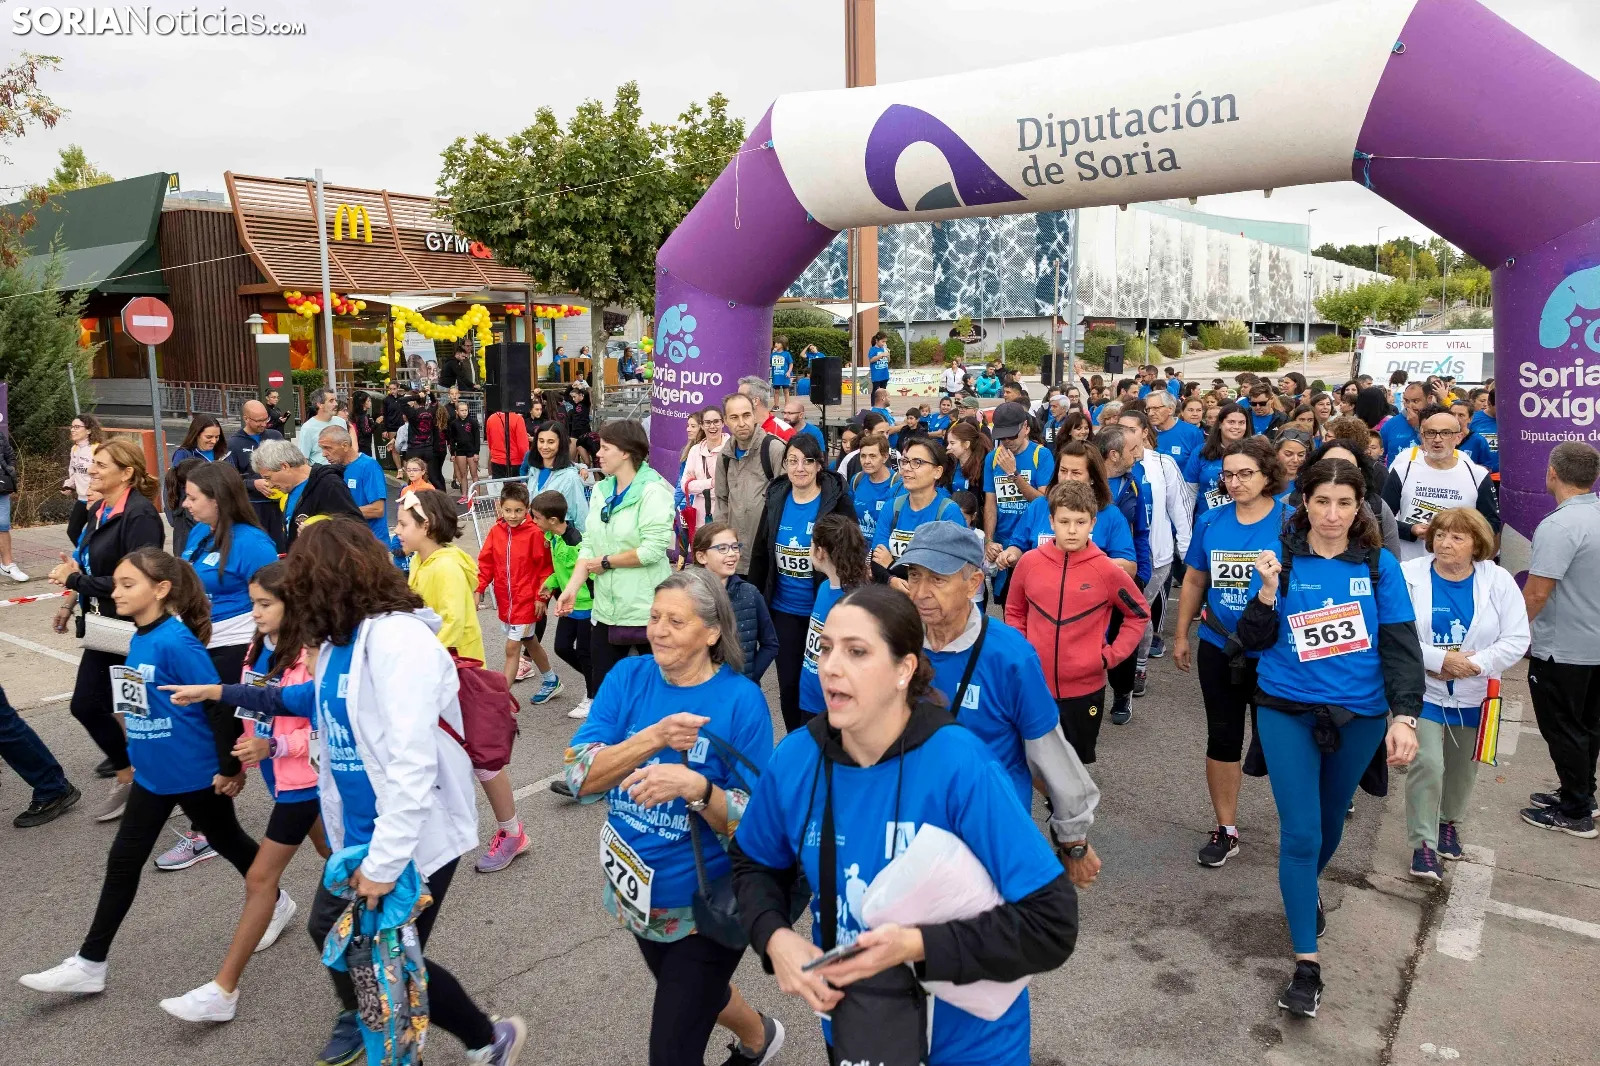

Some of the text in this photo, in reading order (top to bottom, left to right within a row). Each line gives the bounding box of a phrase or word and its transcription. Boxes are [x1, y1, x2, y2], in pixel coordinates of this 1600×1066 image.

[1017, 91, 1240, 157] Diputación
[1021, 142, 1181, 187] de Soria
[1385, 341, 1471, 349] SOPORTE VITAL
[1386, 355, 1466, 374] DIREXIS
[1519, 357, 1600, 388] Soria
[680, 370, 723, 388] puro
[1519, 389, 1600, 426] Oxíg
[1520, 429, 1585, 444] Diputación
[1415, 491, 1449, 499] VALLECANA
[1428, 487, 1460, 496] SILVESTRE
[780, 555, 809, 570] 158
[1218, 563, 1255, 579] 208
[1304, 611, 1329, 620] Carrera
[1330, 605, 1358, 615] solidaria
[1306, 610, 1360, 624] McDonald's Soria
[1304, 620, 1356, 647] 563
[348, 762, 366, 771] Sor
[604, 849, 639, 901] 279
